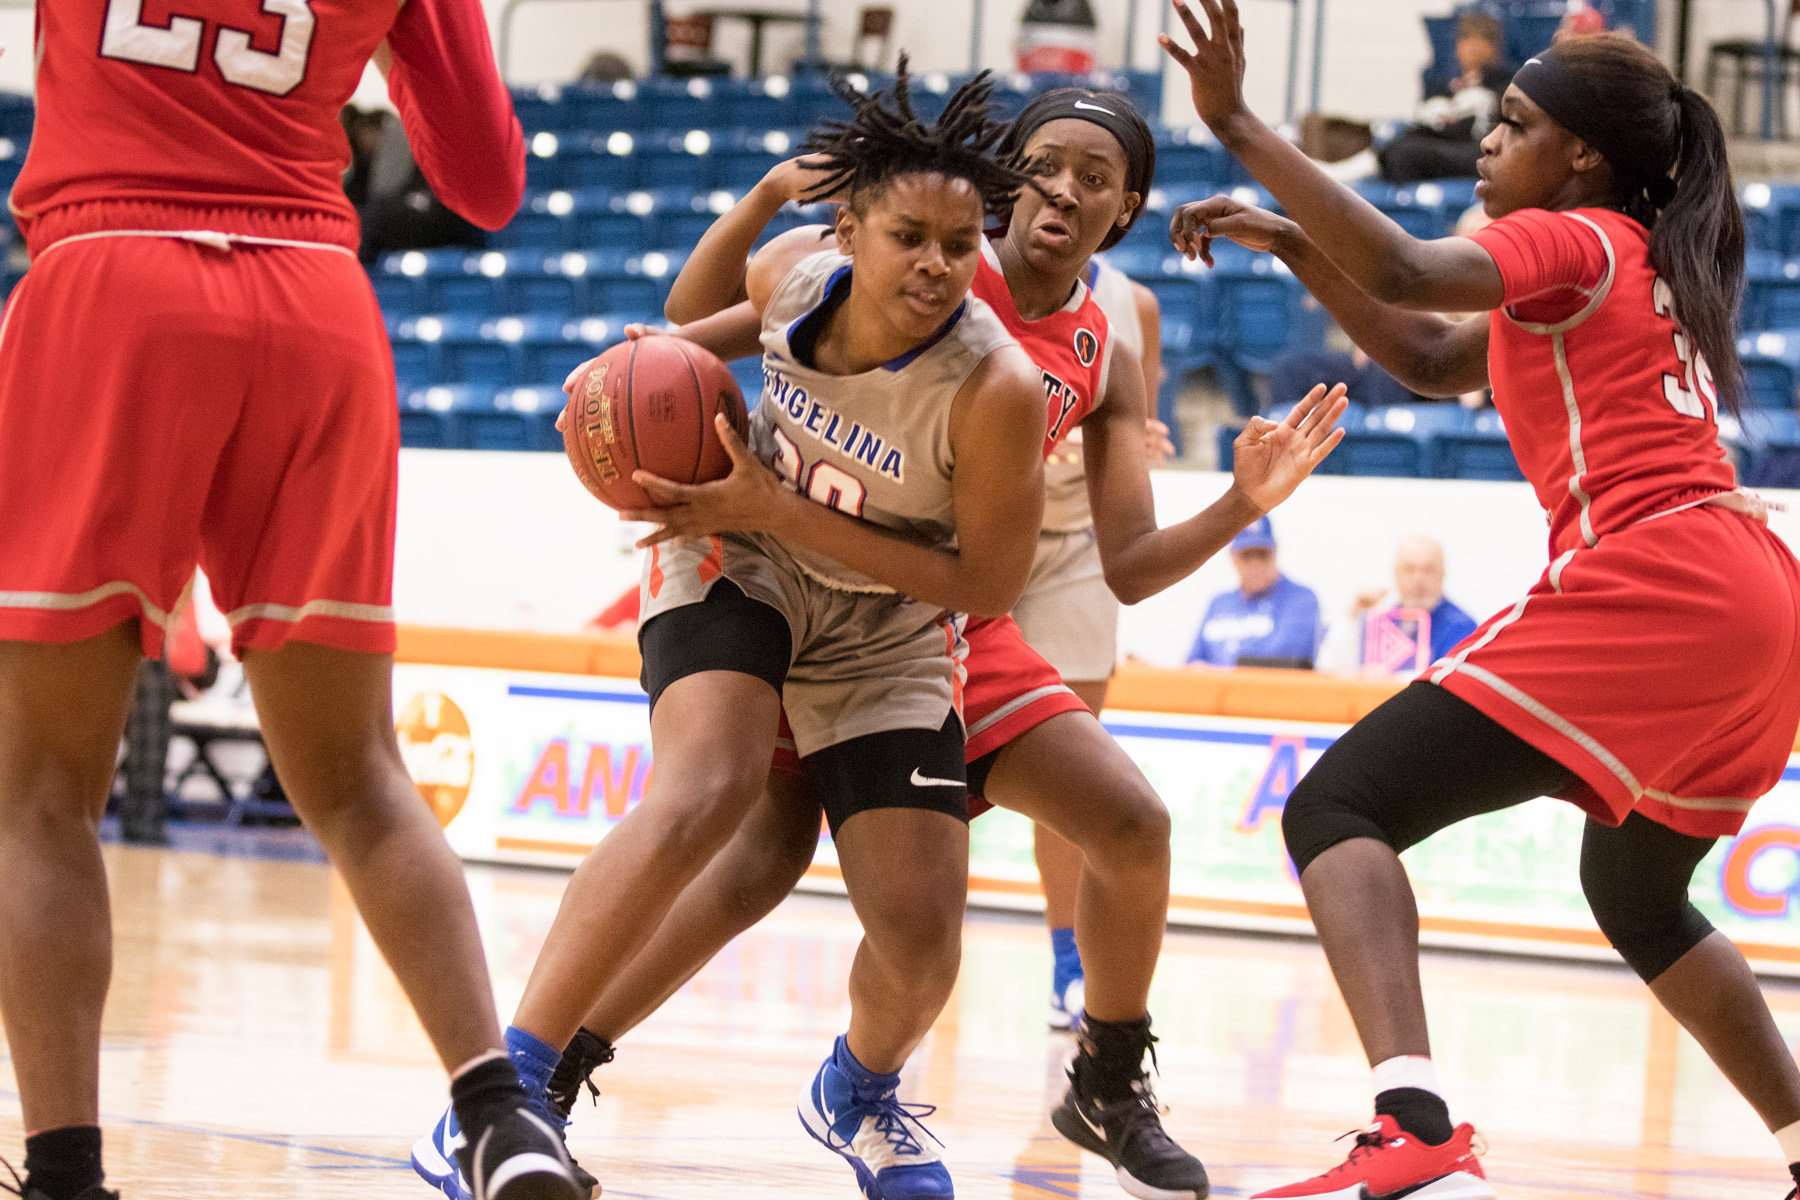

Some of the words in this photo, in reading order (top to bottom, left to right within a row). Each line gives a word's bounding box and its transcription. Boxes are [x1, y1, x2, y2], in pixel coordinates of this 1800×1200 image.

[1653, 275, 1718, 427] 3
[1036, 365, 1080, 442] TY
[514, 737, 655, 821] AN
